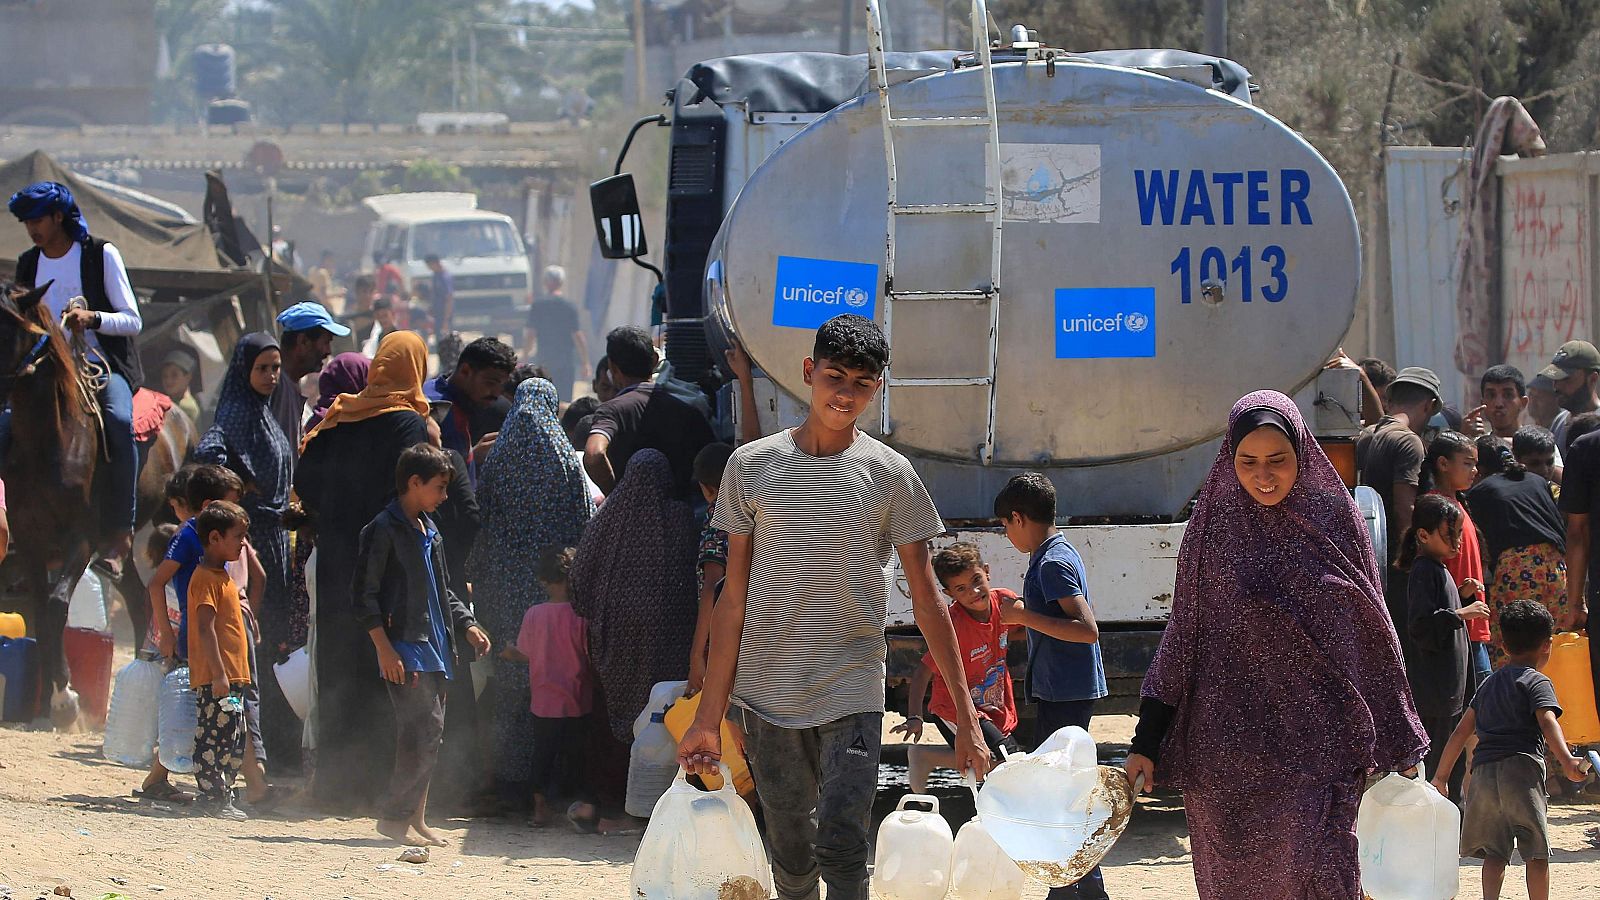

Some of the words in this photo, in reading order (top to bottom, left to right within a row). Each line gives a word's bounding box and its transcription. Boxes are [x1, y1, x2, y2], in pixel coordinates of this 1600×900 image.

[1134, 169, 1313, 226] WATER
[1171, 245, 1289, 304] 1013
[782, 283, 844, 305] unicef
[1062, 313, 1123, 332] unicef
[846, 747, 869, 758] Reebok
